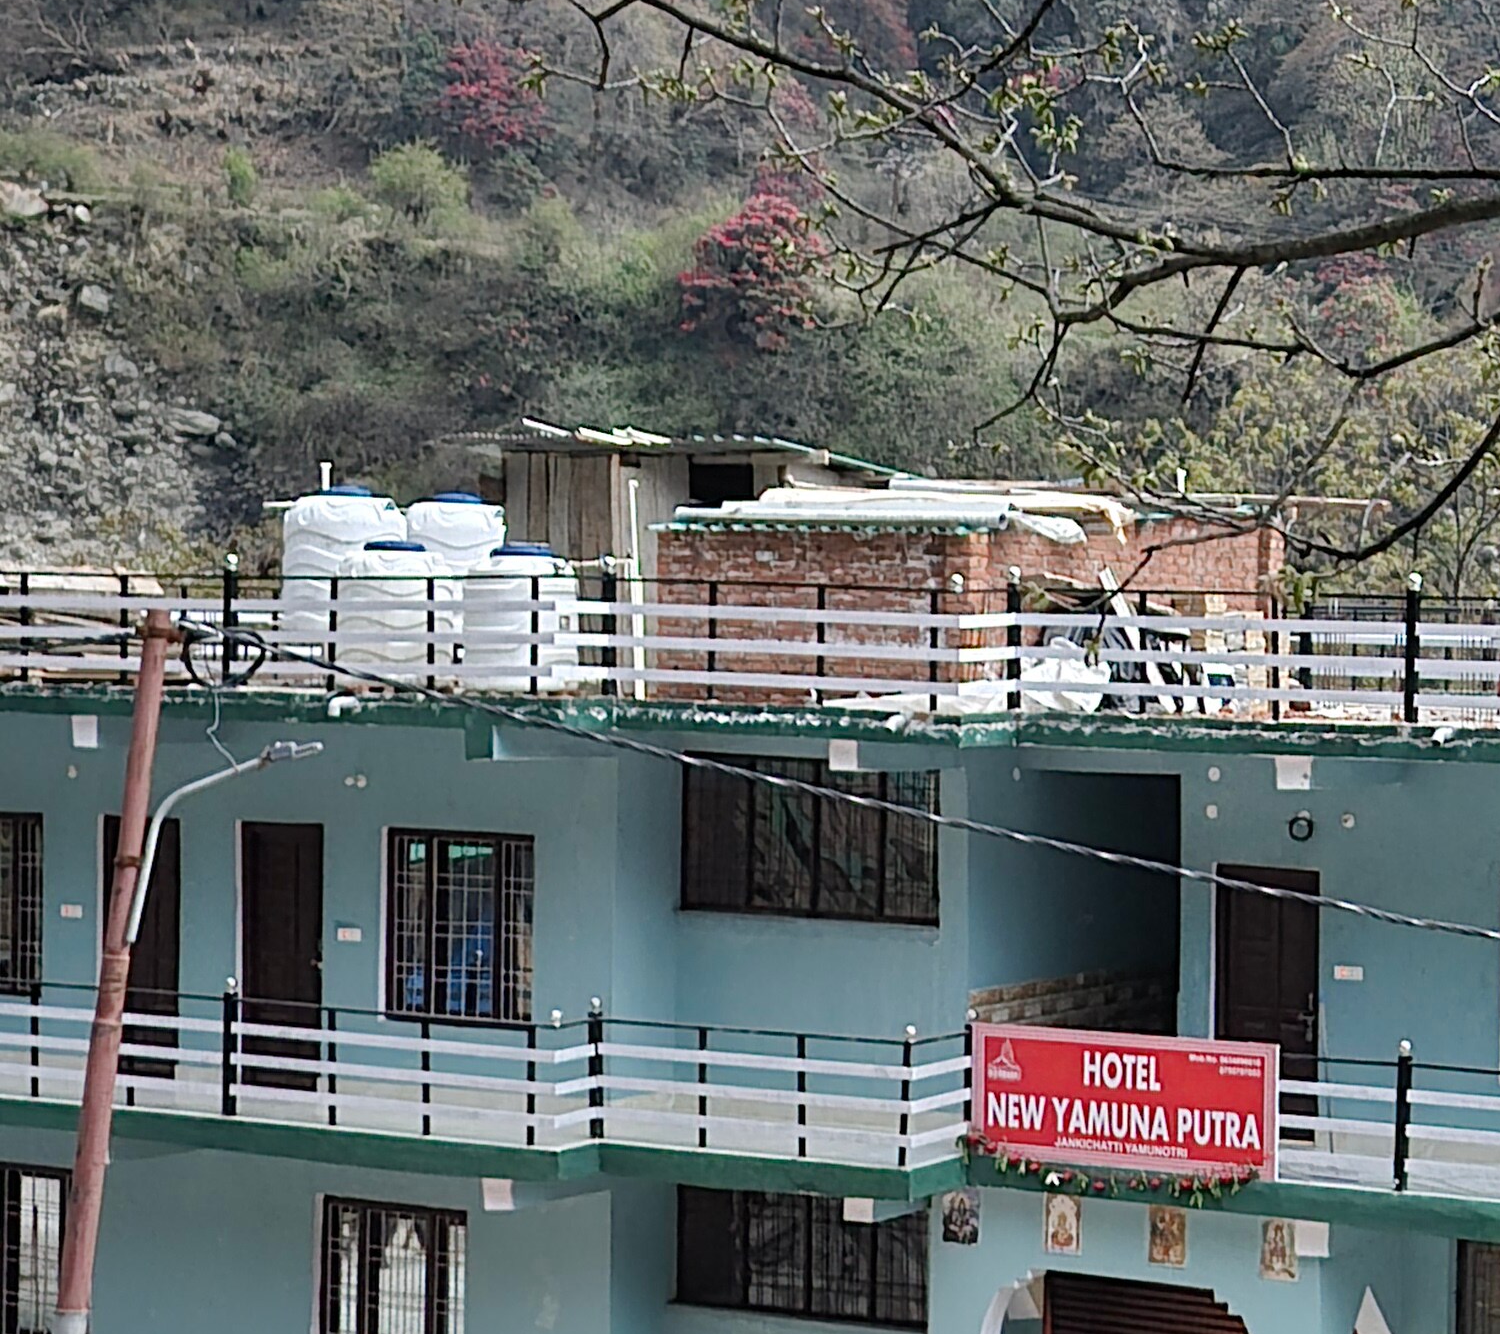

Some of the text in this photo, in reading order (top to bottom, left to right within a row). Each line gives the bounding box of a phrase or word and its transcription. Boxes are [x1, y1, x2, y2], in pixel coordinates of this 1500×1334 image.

[1083, 1050, 1161, 1091] HOTEL
[987, 1092, 1261, 1149] NEW YAMUNA PUTRA
[1054, 1136, 1188, 1158] JANKICHATTI YAMUNOTRI
